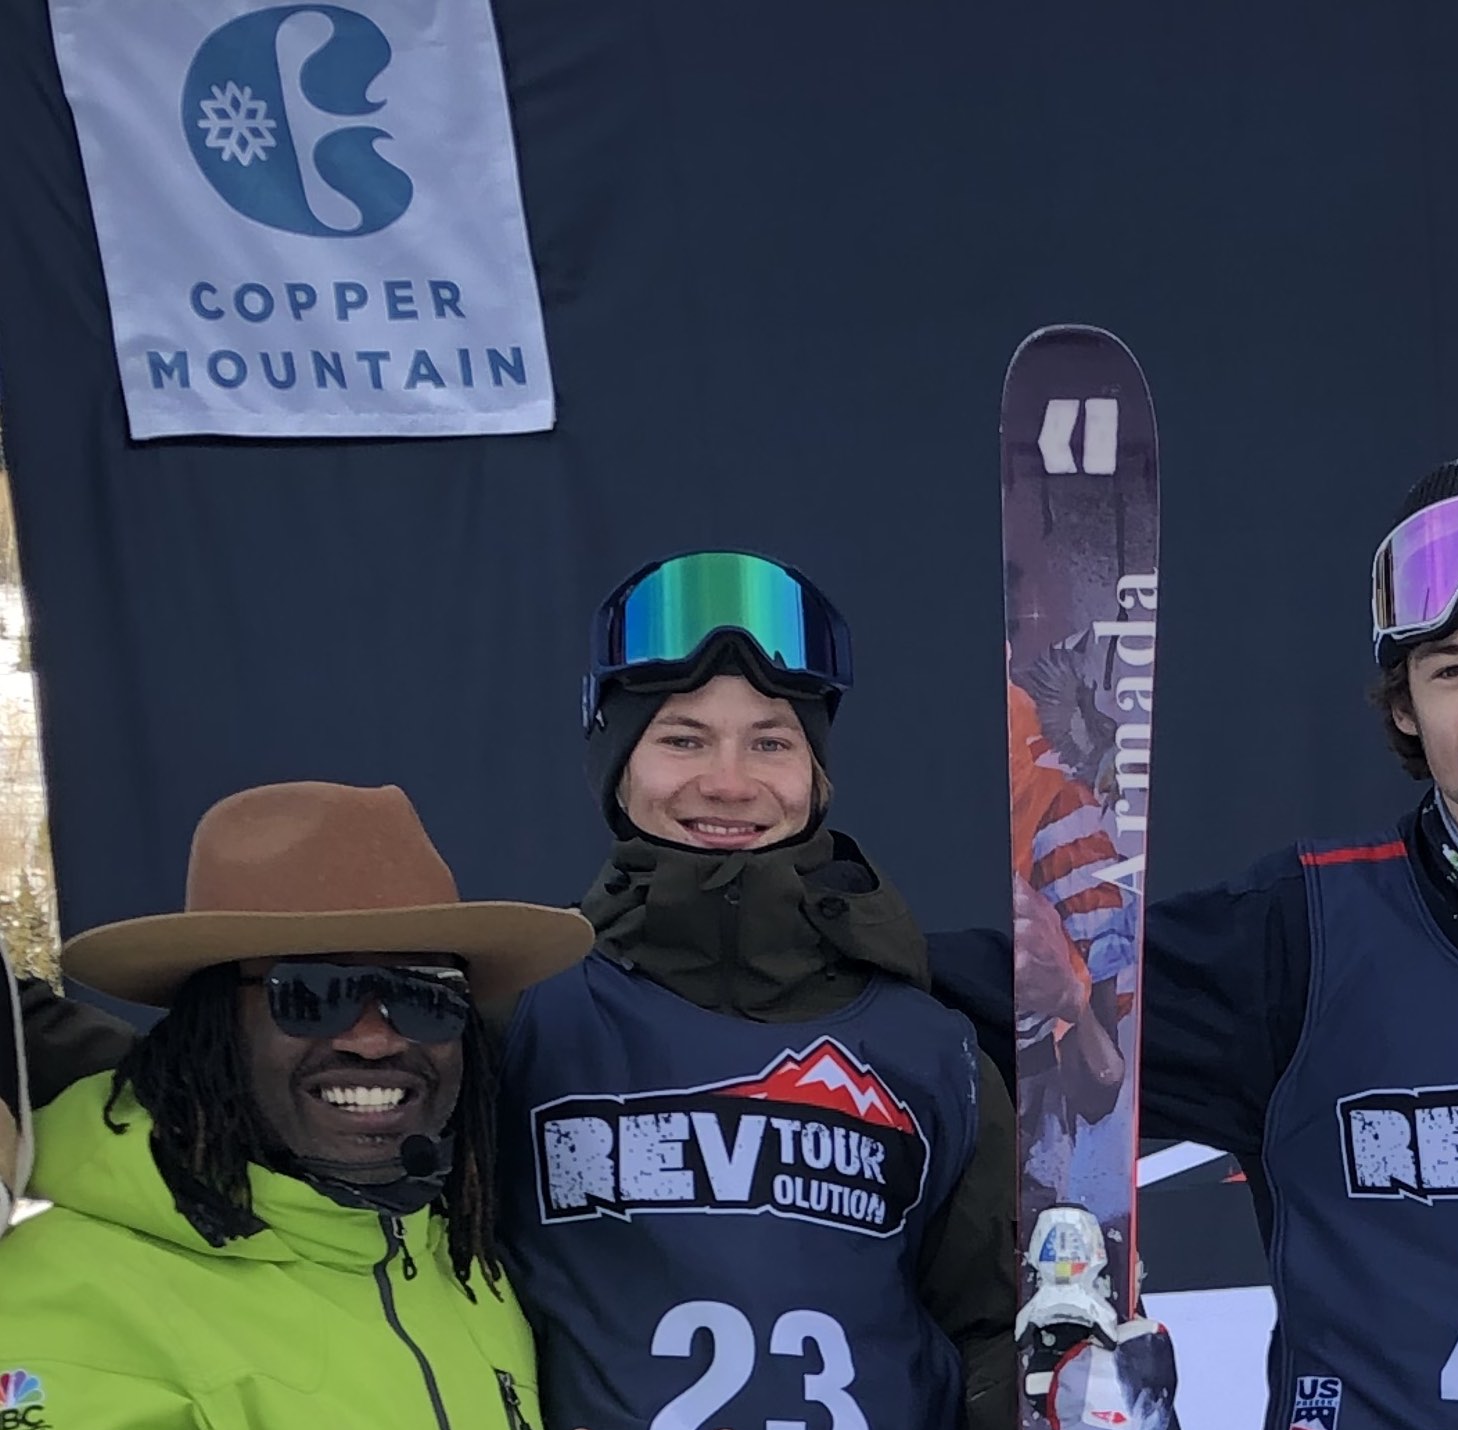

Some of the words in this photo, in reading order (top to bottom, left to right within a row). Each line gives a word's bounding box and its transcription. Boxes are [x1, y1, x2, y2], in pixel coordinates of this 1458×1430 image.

[189, 279, 467, 322] COPPER
[146, 345, 529, 390] MOUNTAIN
[1091, 566, 1158, 896] Armada
[543, 1111, 767, 1210] REV
[770, 1117, 887, 1185] TOUR
[772, 1175, 887, 1225] OLUTION
[1298, 1378, 1339, 1400] US
